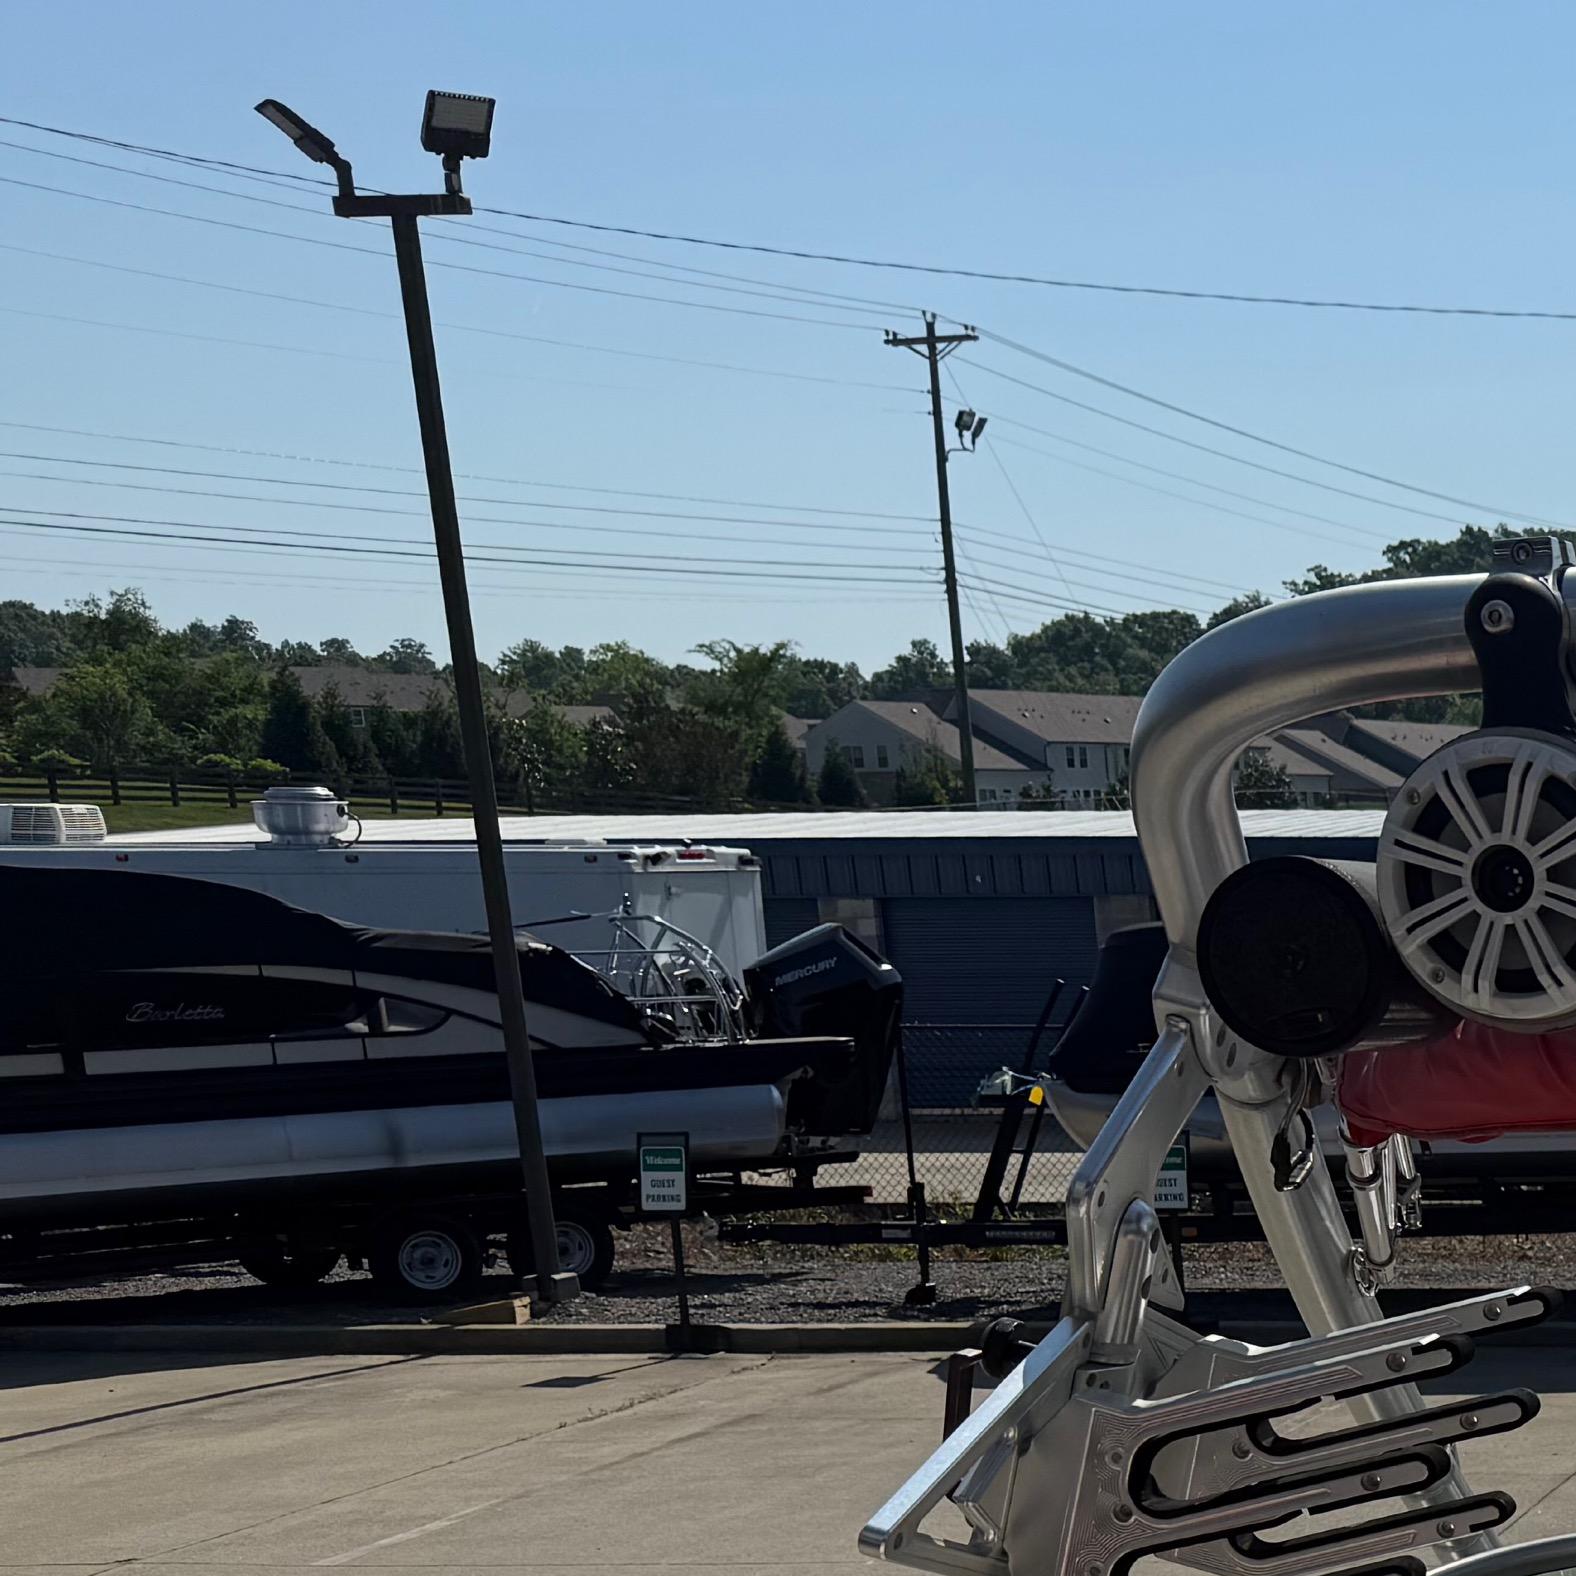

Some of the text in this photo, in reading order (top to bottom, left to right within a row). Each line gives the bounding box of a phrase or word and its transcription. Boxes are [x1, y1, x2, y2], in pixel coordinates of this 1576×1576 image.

[775, 957, 837, 986] MERCURY
[126, 1001, 225, 1022] Barletta
[650, 1179, 675, 1188] GUEST
[1157, 1178, 1177, 1187] UEST
[646, 1194, 681, 1203] PARKING
[1154, 1193, 1184, 1202] ARKING
